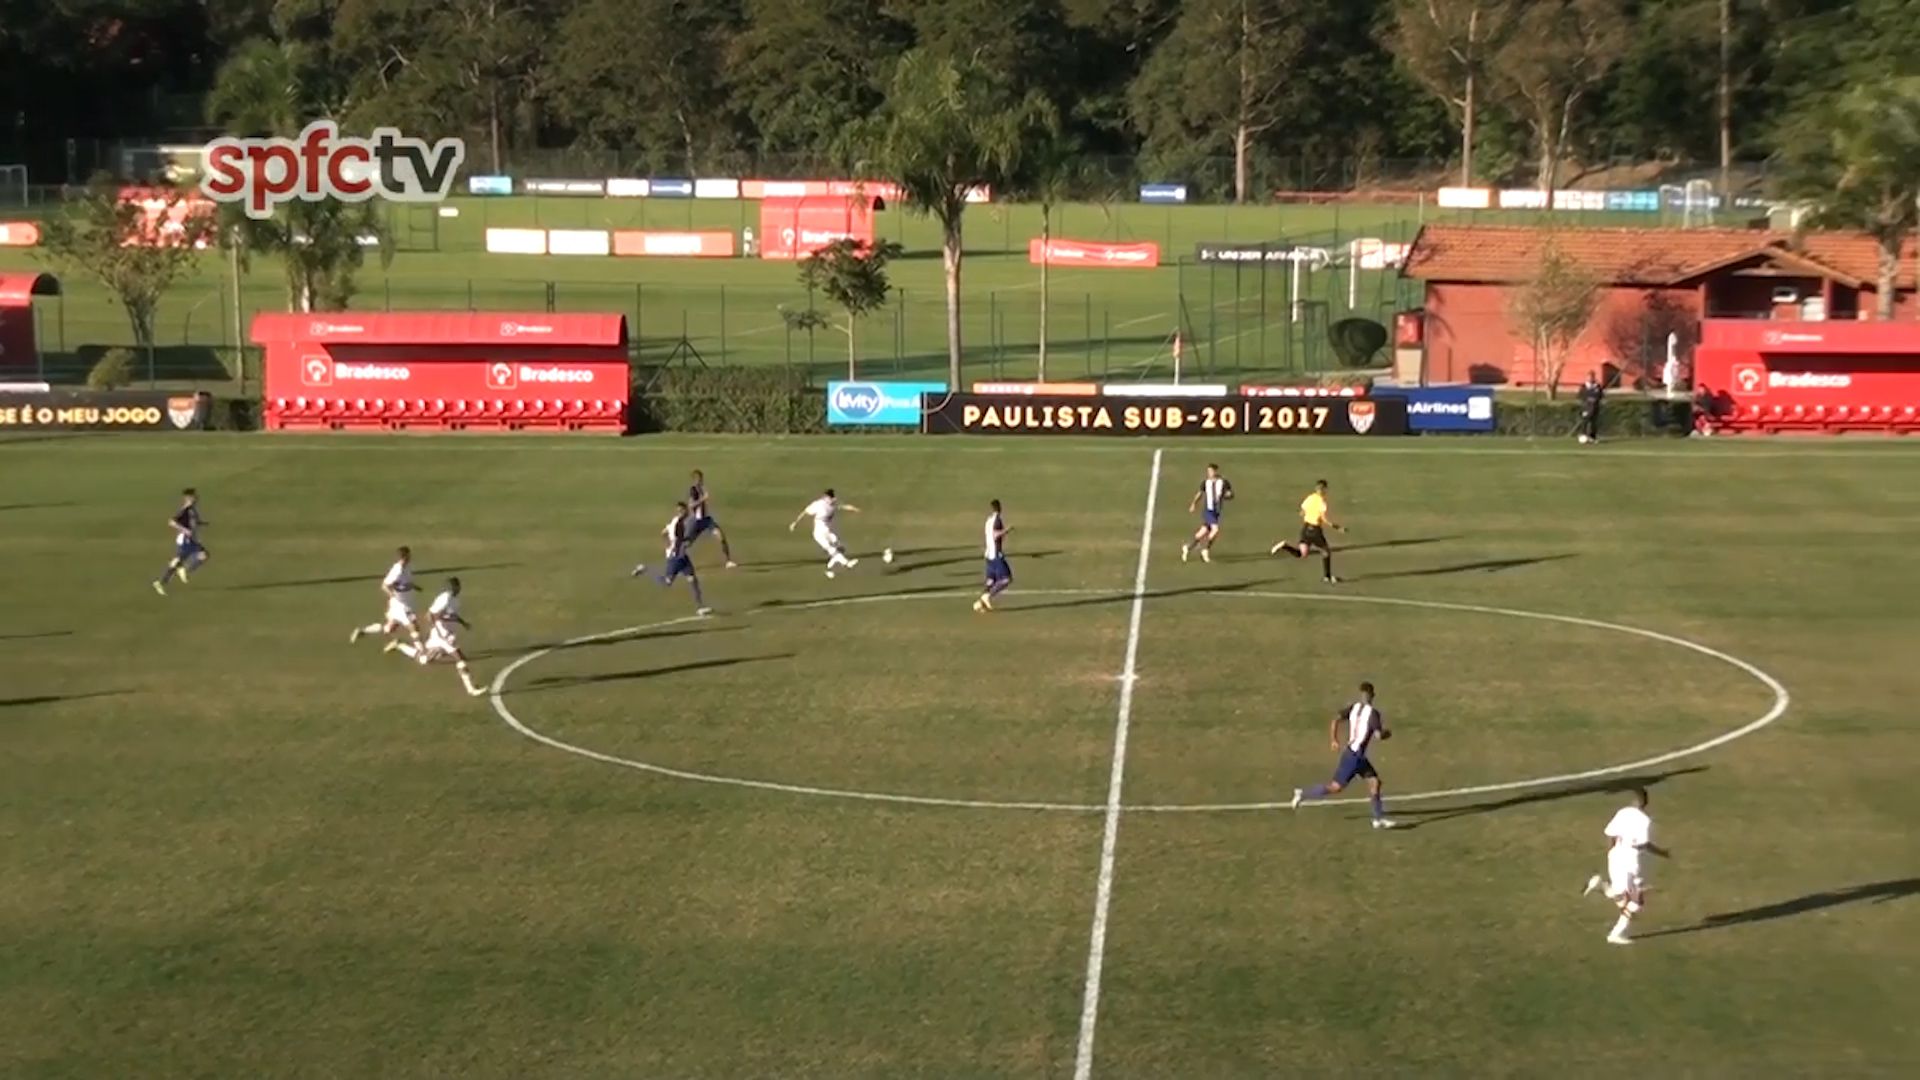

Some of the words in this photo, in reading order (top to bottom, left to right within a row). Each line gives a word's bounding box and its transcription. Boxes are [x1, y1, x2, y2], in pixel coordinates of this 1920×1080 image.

[335, 363, 409, 379] Bradesco
[520, 366, 594, 382] Bradesco
[1768, 372, 1851, 387] Bradesco
[22, 404, 33, 423] É
[37, 408, 53, 423] O
[57, 408, 99, 423] MEU
[103, 407, 161, 424] JOGO
[963, 405, 1112, 428] PAULISTA
[1124, 406, 1236, 429] SUB-20
[1258, 406, 1329, 429] 2017
